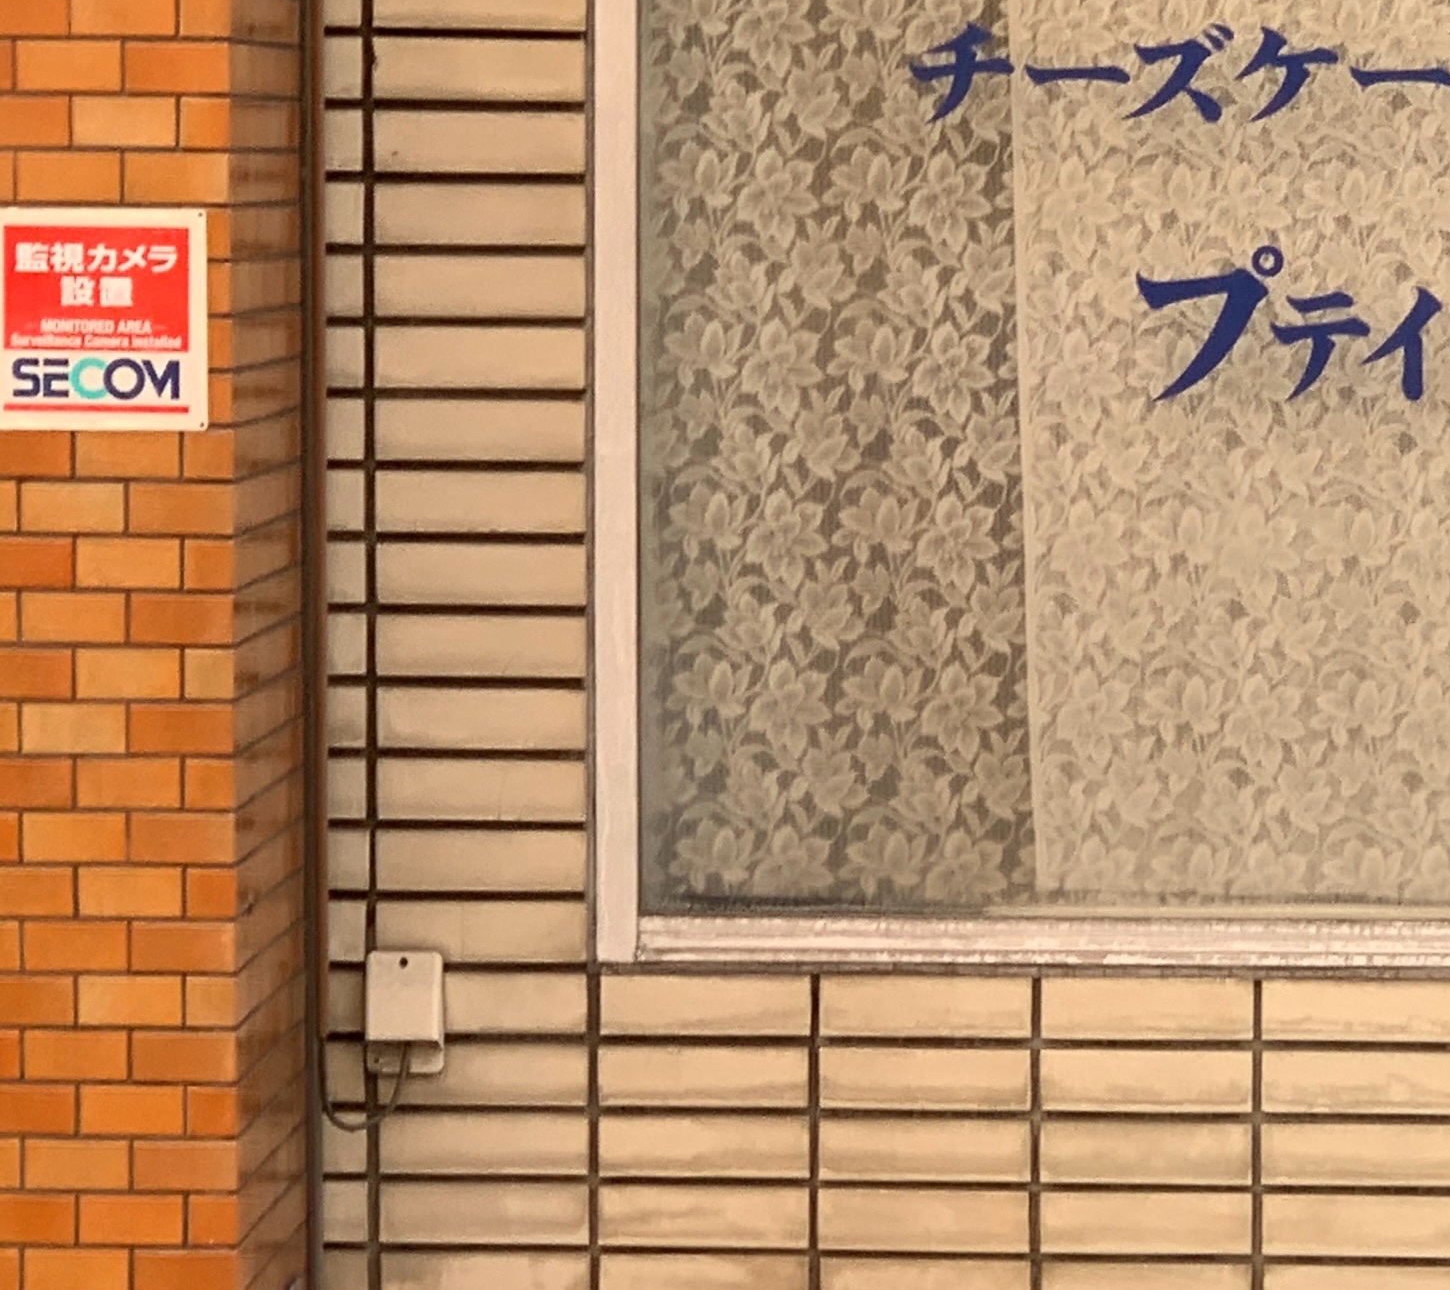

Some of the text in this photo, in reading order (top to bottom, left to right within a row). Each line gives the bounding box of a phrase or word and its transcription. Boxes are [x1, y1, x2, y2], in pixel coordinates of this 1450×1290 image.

[15, 242, 178, 273] 監視カメラ
[60, 276, 134, 307] 設置
[12, 358, 180, 400] SECOM
